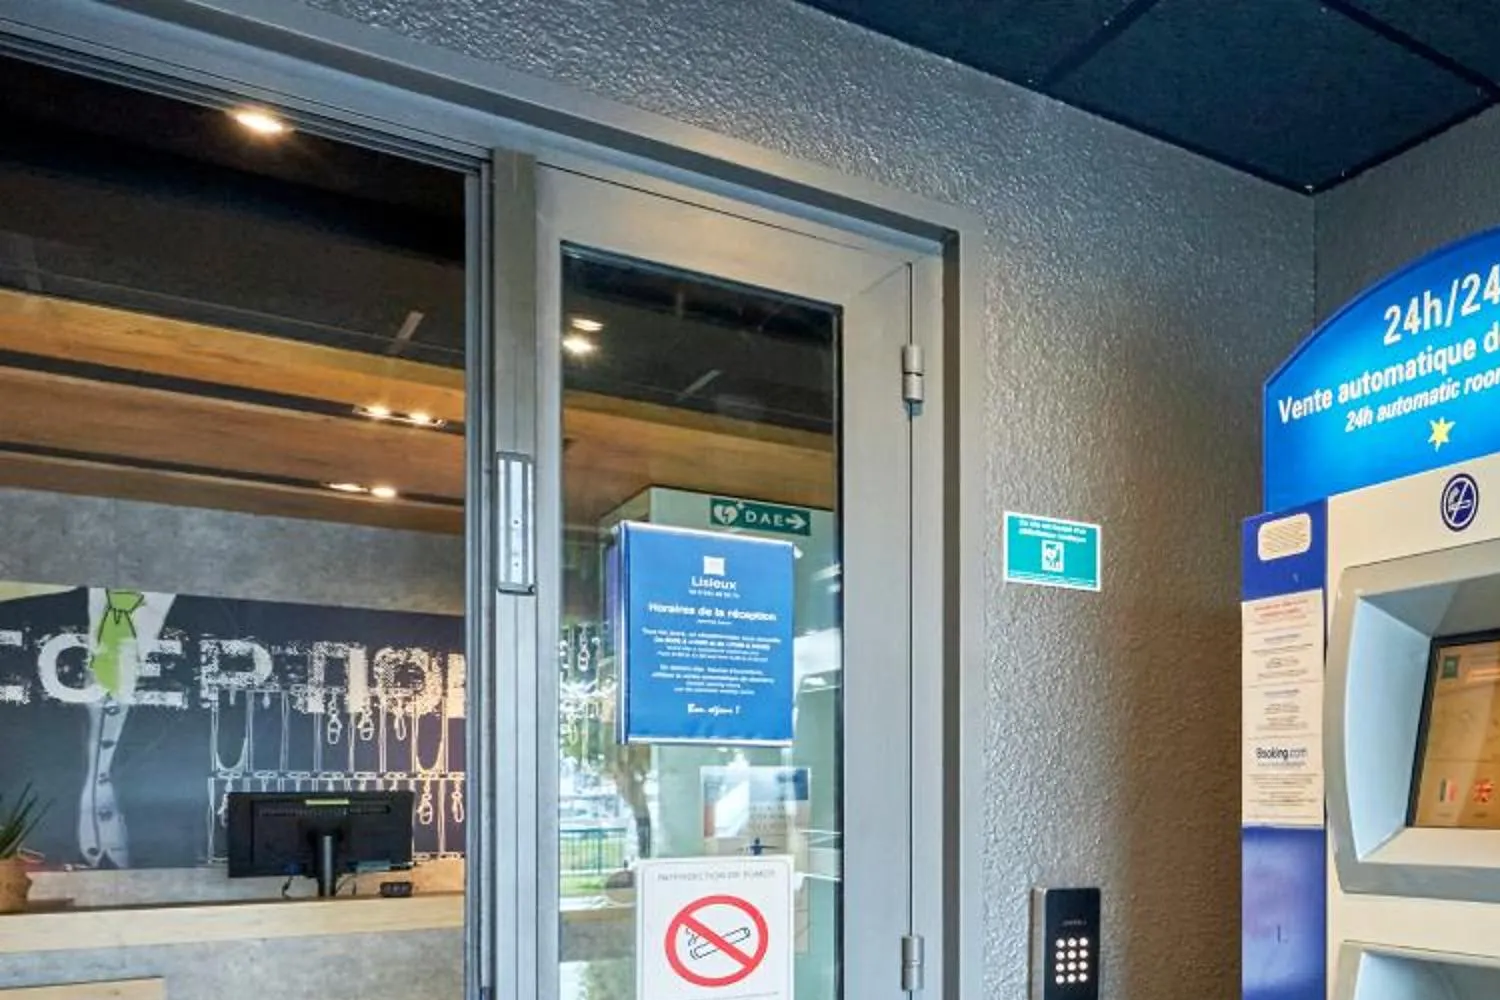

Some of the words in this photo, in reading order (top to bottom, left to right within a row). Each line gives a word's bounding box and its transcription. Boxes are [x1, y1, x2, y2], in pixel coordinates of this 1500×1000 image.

[1277, 389, 1333, 424] Vente
[1338, 339, 1476, 406] automatique
[1344, 406, 1373, 433] 24h
[1376, 377, 1461, 424] automatic
[745, 510, 785, 527] DAE
[691, 576, 737, 590] Lisieux
[698, 605, 713, 616] de
